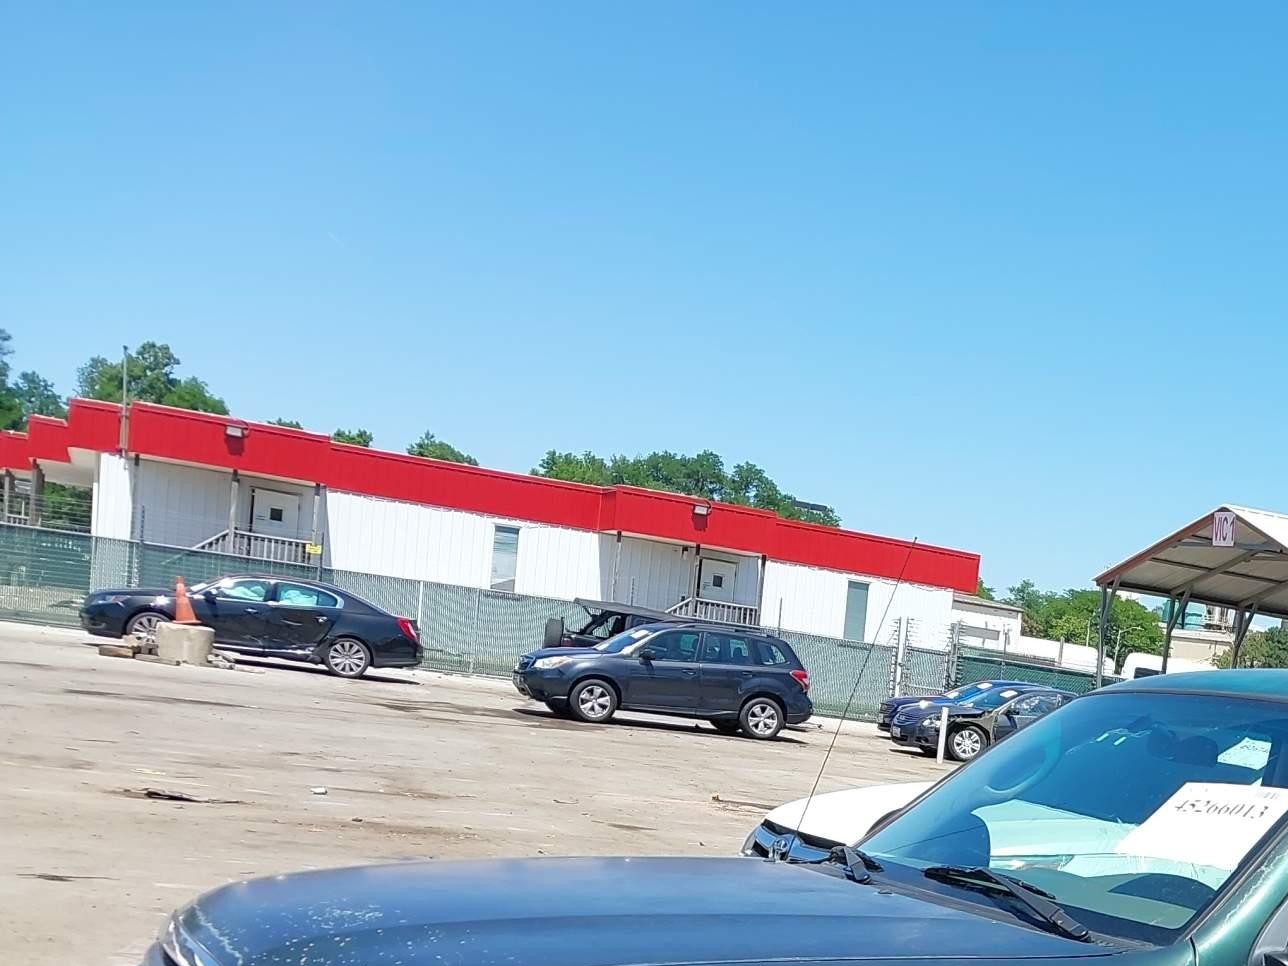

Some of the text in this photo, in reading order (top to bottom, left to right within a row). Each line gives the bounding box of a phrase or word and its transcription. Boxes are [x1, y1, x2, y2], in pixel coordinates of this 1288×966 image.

[1214, 516, 1236, 542] VIC 1
[1175, 799, 1269, 819] 45266013
